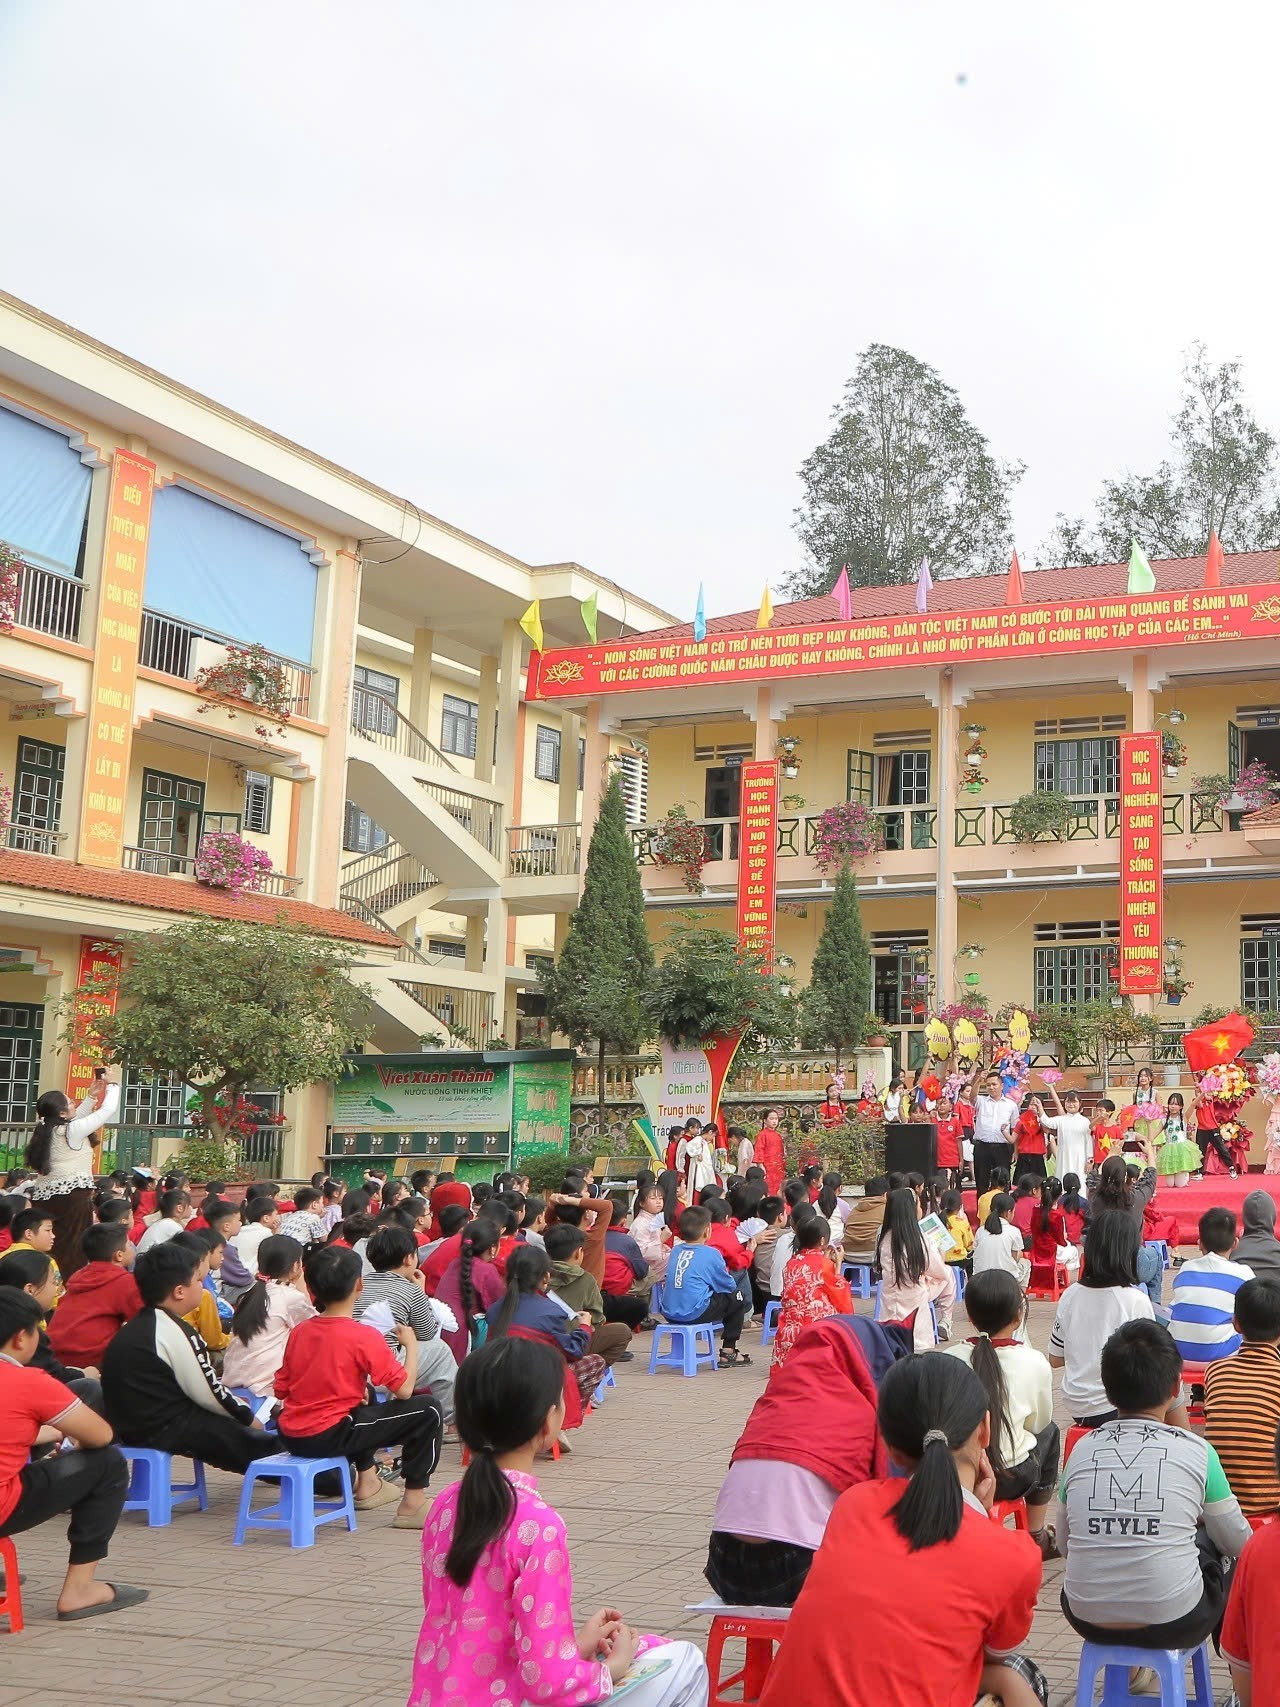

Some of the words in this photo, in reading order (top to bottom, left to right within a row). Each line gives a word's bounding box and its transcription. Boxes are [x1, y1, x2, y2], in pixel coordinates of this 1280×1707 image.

[604, 650, 626, 664] NON
[629, 647, 657, 663] SÔNG
[660, 644, 681, 661] VIỆT
[684, 643, 707, 657] NAM
[711, 640, 724, 655] CÓ
[728, 635, 748, 652] TRỞ
[751, 635, 773, 650] NÊN
[776, 632, 799, 648] TƯƠI
[802, 631, 823, 648] ĐẸP
[827, 630, 847, 644] HAY
[850, 625, 890, 641] KHÔNG,
[894, 621, 917, 637] DÂN
[920, 619, 941, 636] TỘC
[944, 616, 968, 633] VIỆT
[971, 616, 998, 630] NAM
[1002, 611, 1017, 627] CÓ
[1020, 609, 1051, 626] BƯỚC
[1055, 606, 1072, 623] TỚI
[1076, 605, 1095, 621] ĐÀI
[1099, 604, 1127, 619] VINH
[1130, 600, 1170, 616] QUANG
[1174, 594, 1189, 612] ĐỂ
[1193, 593, 1226, 611] SÁNH
[1229, 594, 1248, 608] VAI
[600, 668, 616, 682] VỚI
[619, 666, 640, 682] CÁC
[642, 663, 676, 679] CƯỜNG
[680, 658, 707, 676] QUỐC
[710, 657, 735, 673] NĂM
[739, 654, 766, 670] CHÂU
[770, 652, 798, 669] ĐƯỢC
[802, 650, 821, 665] HAY
[825, 646, 865, 662] KHÔNG,
[869, 641, 902, 658] CHÍNH
[906, 639, 920, 655] LÀ
[923, 637, 946, 653] NHỜ
[949, 635, 974, 654] MỘT
[977, 630, 1008, 649] PHẦN
[1012, 630, 1034, 646] LỚN
[1037, 625, 1046, 644] Ở
[1049, 627, 1081, 643] CÔNG
[1084, 625, 1108, 642] HỌC
[1112, 621, 1134, 640] TẬP
[1138, 617, 1162, 635] CỦA
[1166, 617, 1189, 633] CÁC
[1132, 749, 1150, 767] HỌC
[745, 777, 775, 788] TRƯỜNG
[1131, 768, 1151, 786] TRẢI
[750, 791, 768, 802] HỌC
[1124, 792, 1159, 809] NGHIỆM
[746, 804, 771, 816] HẠNH
[746, 817, 771, 828] PHÚC
[1129, 813, 1154, 829] SÁNG
[750, 831, 766, 842] NƠI
[1132, 836, 1150, 852] TẠO
[748, 843, 768, 855] TIẾP
[748, 857, 767, 868] SỨC
[1129, 854, 1154, 873] SỐNG
[751, 869, 763, 881] ĐỂ
[747, 884, 766, 895] CÁC
[1127, 878, 1156, 894] TRÁCH
[749, 899, 763, 908] EM
[1127, 900, 1156, 919] NHIỆM
[744, 911, 768, 922] VỮNG
[1132, 923, 1150, 938] YÊU
[1123, 945, 1159, 960] THƯƠNG
[72, 1063, 93, 1079] SÁCH
[667, 1083, 692, 1095] Chăm
[695, 1080, 709, 1094] chỉ
[658, 1104, 684, 1118] Trung
[686, 1103, 705, 1117] thực
[676, 1250, 694, 1287] BOYS
[1089, 1447, 1167, 1512] M
[1088, 1518, 1161, 1536] STYLE
